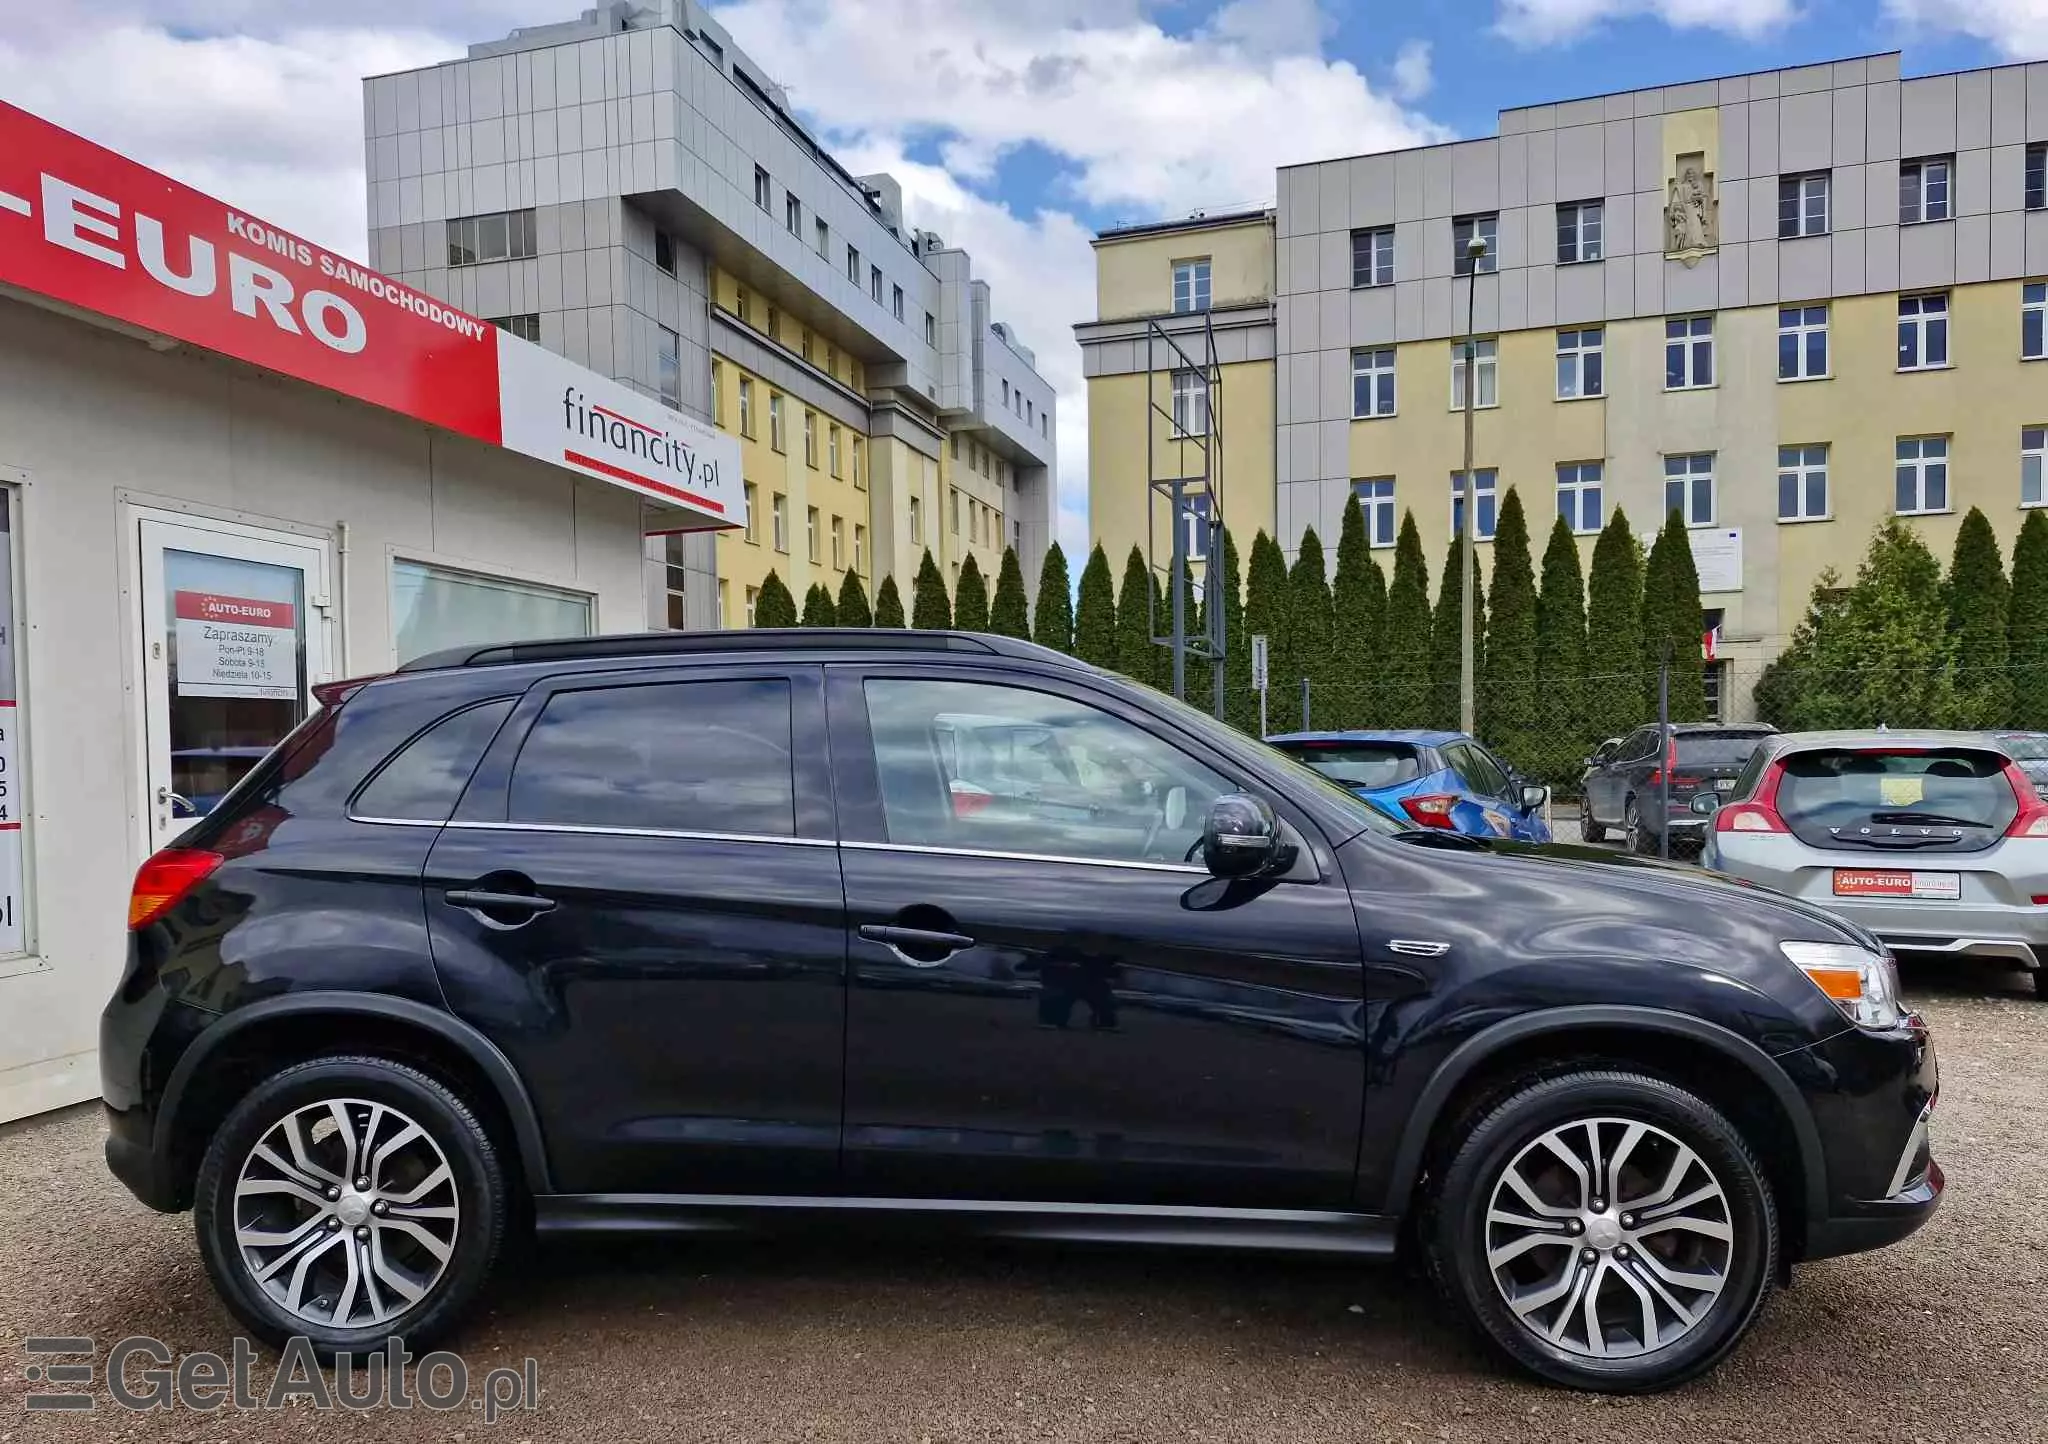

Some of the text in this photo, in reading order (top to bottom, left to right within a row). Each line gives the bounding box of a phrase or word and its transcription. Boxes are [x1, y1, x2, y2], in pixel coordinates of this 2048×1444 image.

[227, 211, 485, 343] KOMIS SAMOCHODOWY
[562, 386, 720, 489] financity.pl
[208, 603, 272, 618] AUTO-EURO
[204, 625, 272, 648] Zapraszamy
[250, 670, 273, 681] 10-15
[1829, 826, 1962, 836] VOLVO
[1841, 876, 1911, 887] AUTO-EURO
